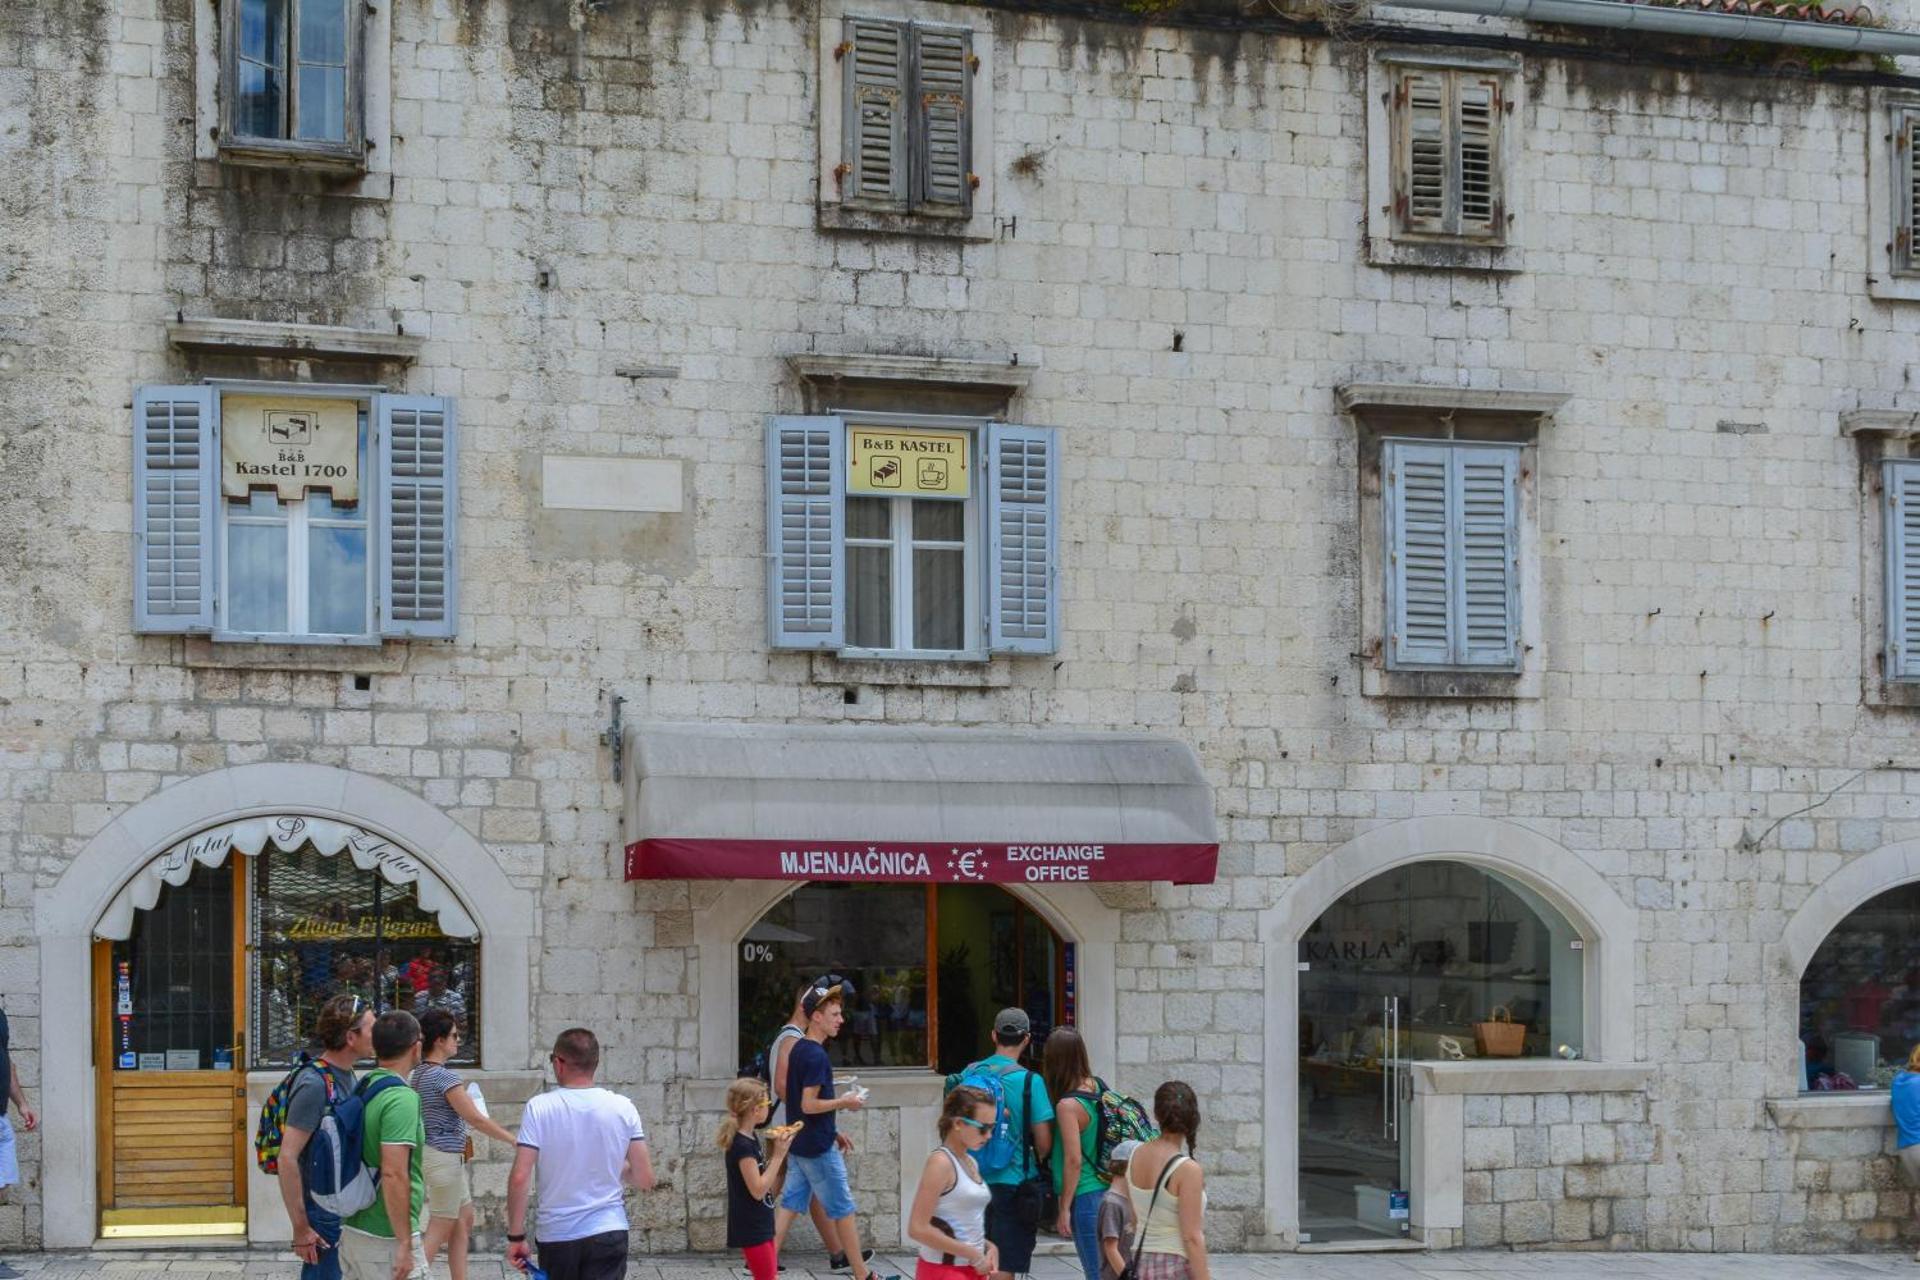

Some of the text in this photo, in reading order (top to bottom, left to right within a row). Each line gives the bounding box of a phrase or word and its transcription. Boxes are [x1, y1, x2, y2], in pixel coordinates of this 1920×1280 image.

[863, 438, 955, 454] B&B KASTEL
[278, 451, 305, 463] B&B
[235, 461, 348, 478] Kastel 1700
[780, 847, 932, 876] MJENJAČNICA
[1007, 845, 1105, 862] EXCHANGE
[1025, 865, 1090, 881] OFFICE
[743, 943, 774, 963] 0%
[1305, 941, 1392, 961] KARLA
